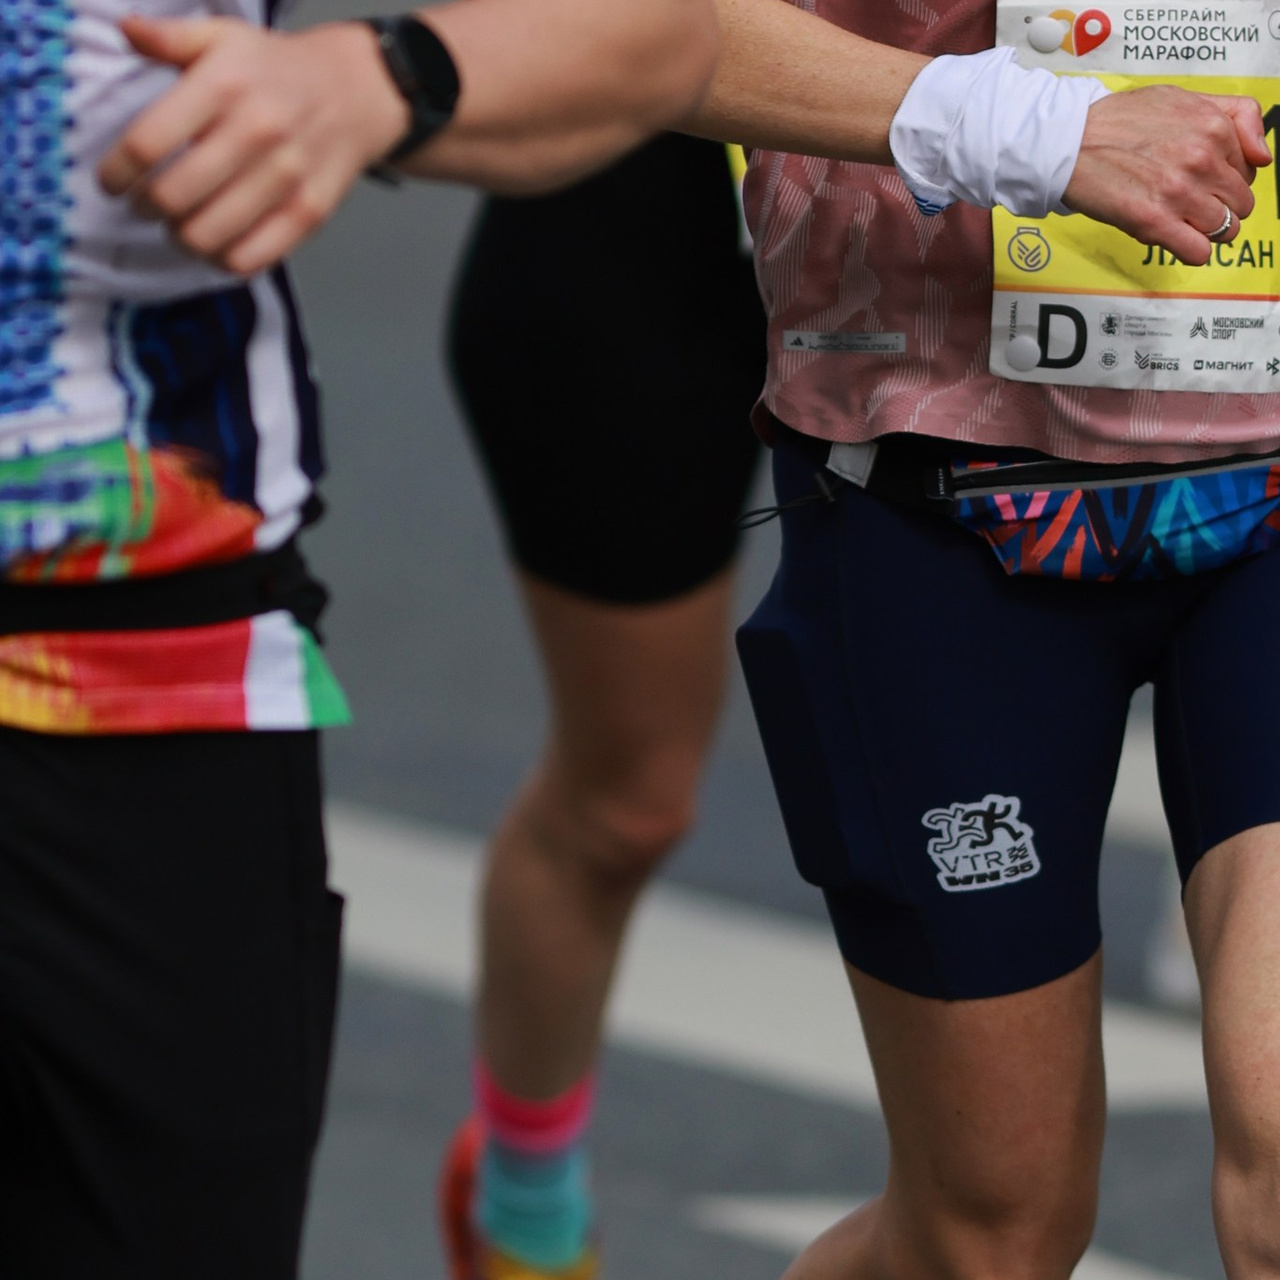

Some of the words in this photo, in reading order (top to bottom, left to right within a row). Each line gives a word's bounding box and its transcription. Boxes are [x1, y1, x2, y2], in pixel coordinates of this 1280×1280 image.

[1123, 8, 1226, 22] СБЕРПРАЙМ
[1123, 24, 1259, 42] МОСКОВСКИЙ
[1123, 45, 1227, 61] МАРАФОН
[1212, 316, 1265, 329] МОСКОВСКИЙ
[1037, 303, 1088, 369] D
[1212, 329, 1236, 340] СПОРТ
[1150, 361, 1180, 371] BRICS
